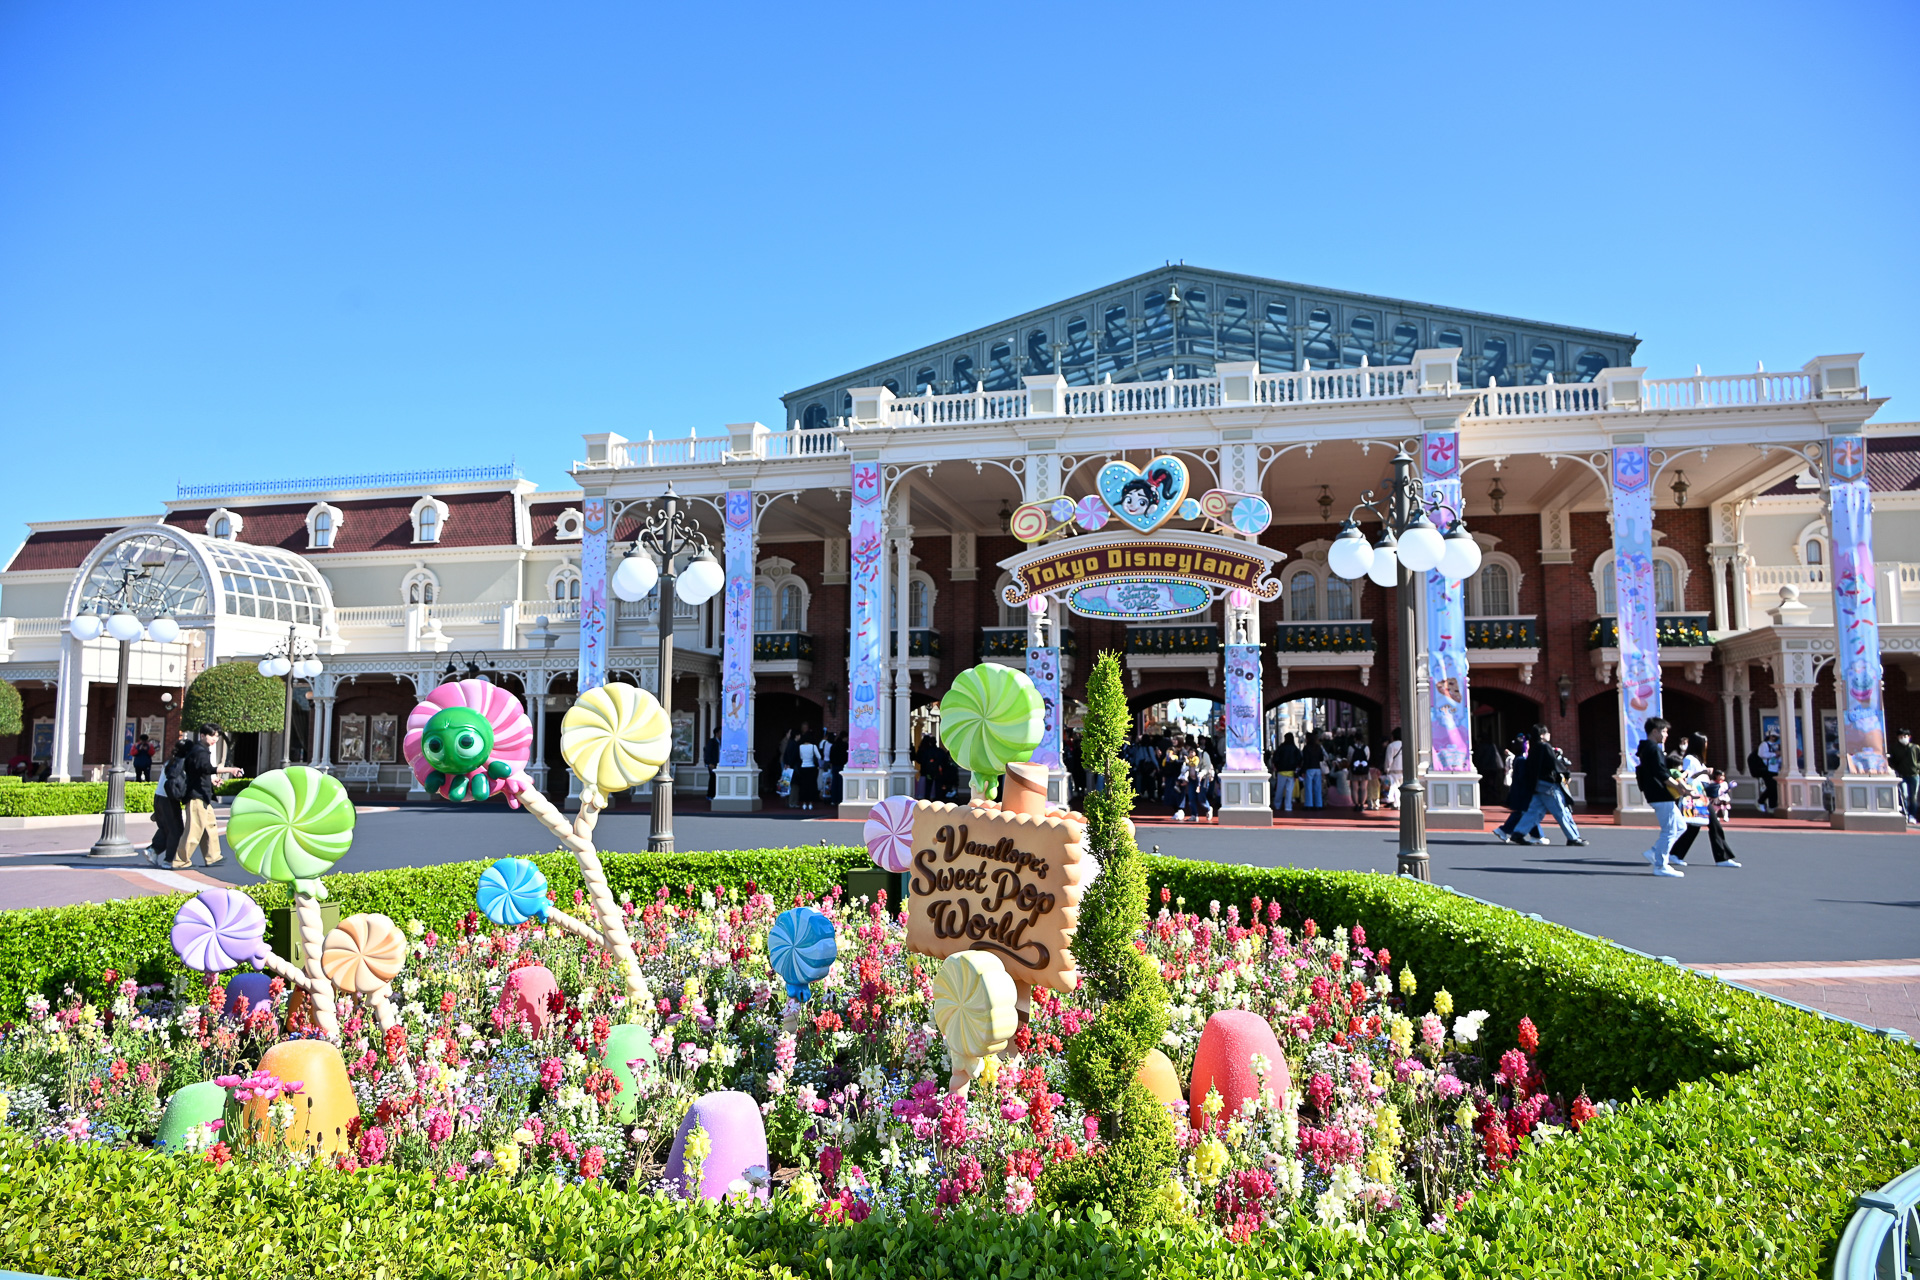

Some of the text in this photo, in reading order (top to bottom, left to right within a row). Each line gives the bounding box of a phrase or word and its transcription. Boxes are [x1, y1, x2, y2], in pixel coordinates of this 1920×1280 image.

[1028, 550, 1250, 585] Tokyo Disneyland
[936, 824, 1049, 879] Vanellope's
[911, 849, 1055, 927] Sweet Pop
[927, 898, 1050, 970] World
